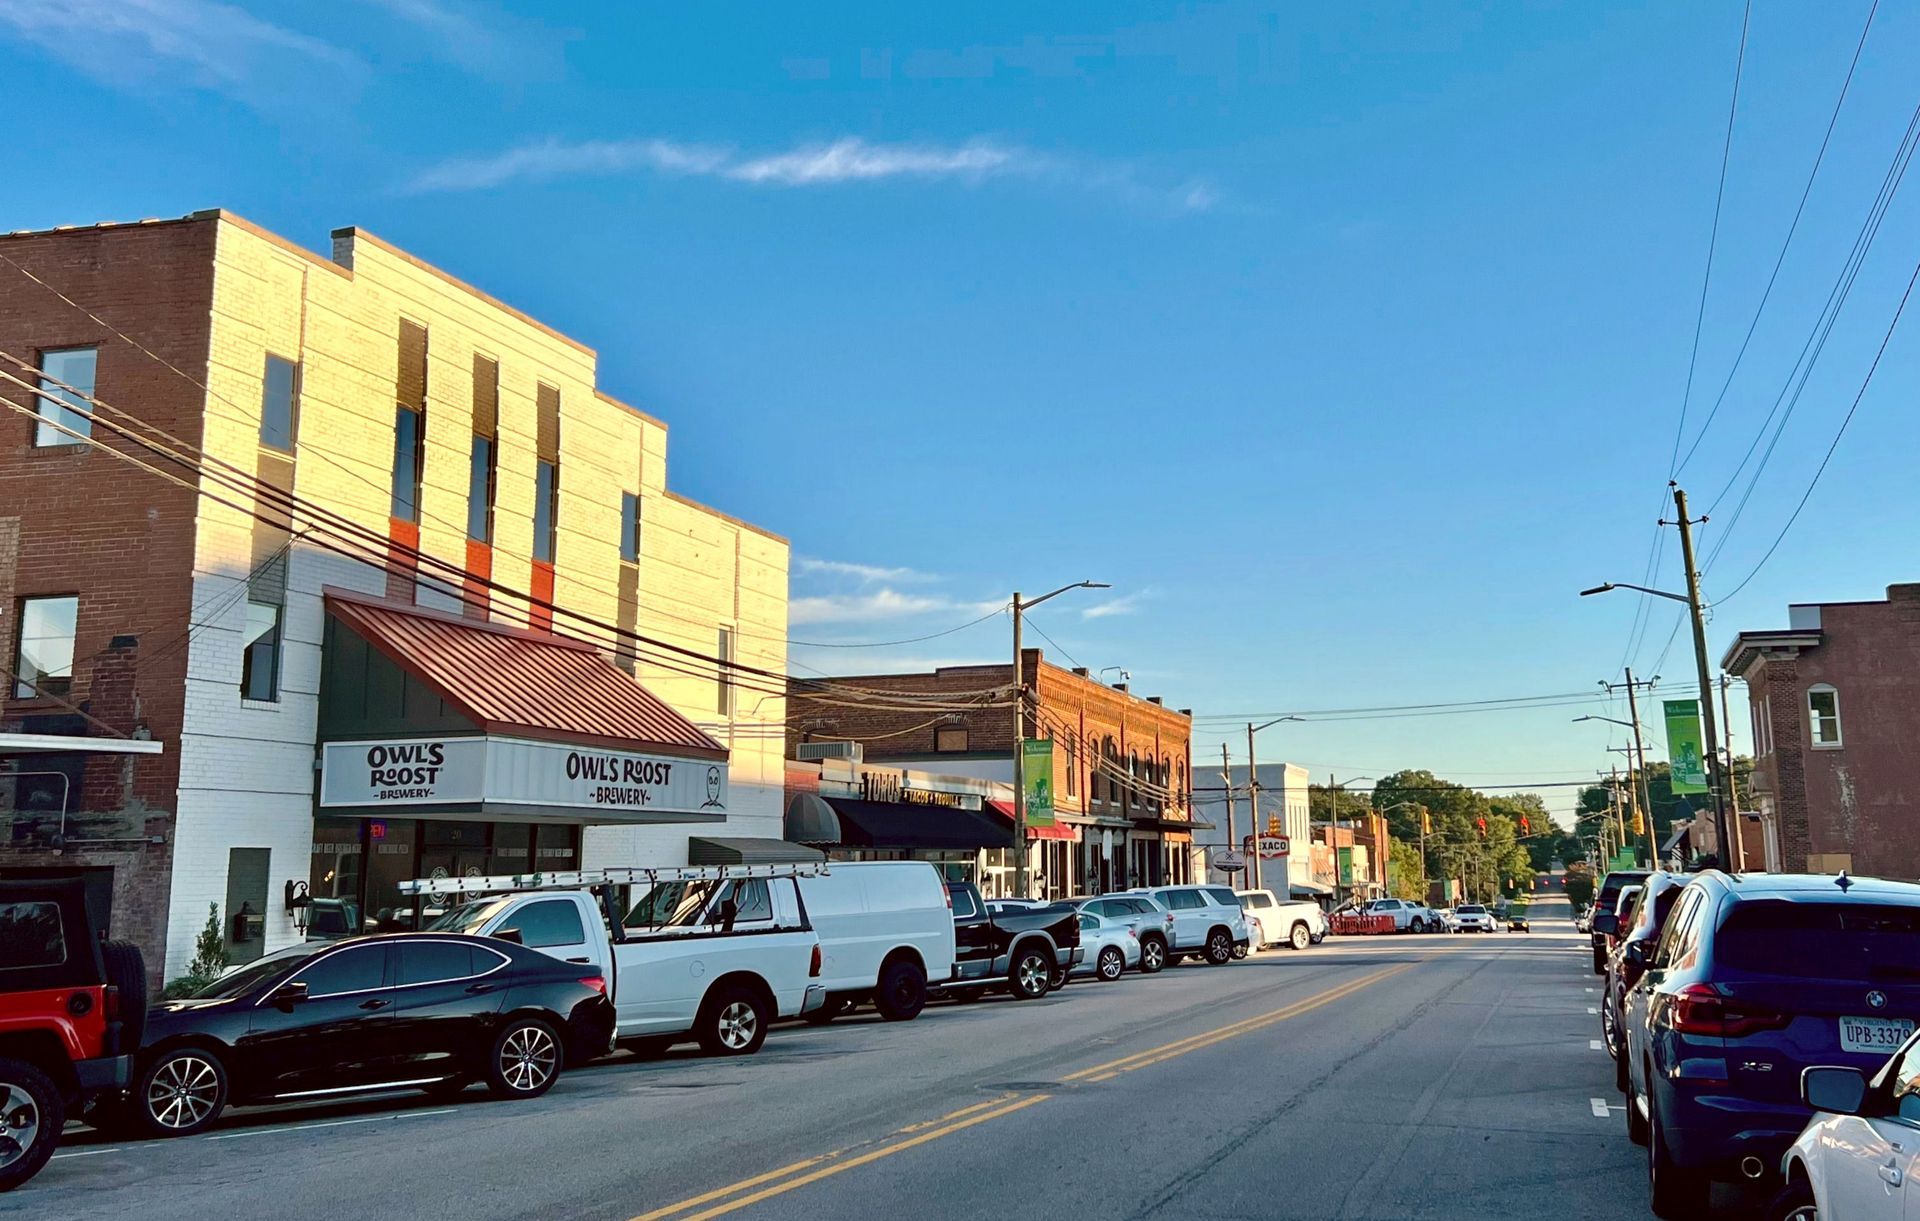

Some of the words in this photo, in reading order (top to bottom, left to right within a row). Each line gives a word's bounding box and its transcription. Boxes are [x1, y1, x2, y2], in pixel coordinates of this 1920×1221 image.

[367, 743, 444, 768] OWL'S
[370, 767, 439, 787] ROOST
[566, 752, 619, 782] OWL'S
[623, 759, 672, 785] ROOST
[1846, 1025, 1911, 1045] UPB-3379
[1739, 1061, 1773, 1072] X3
